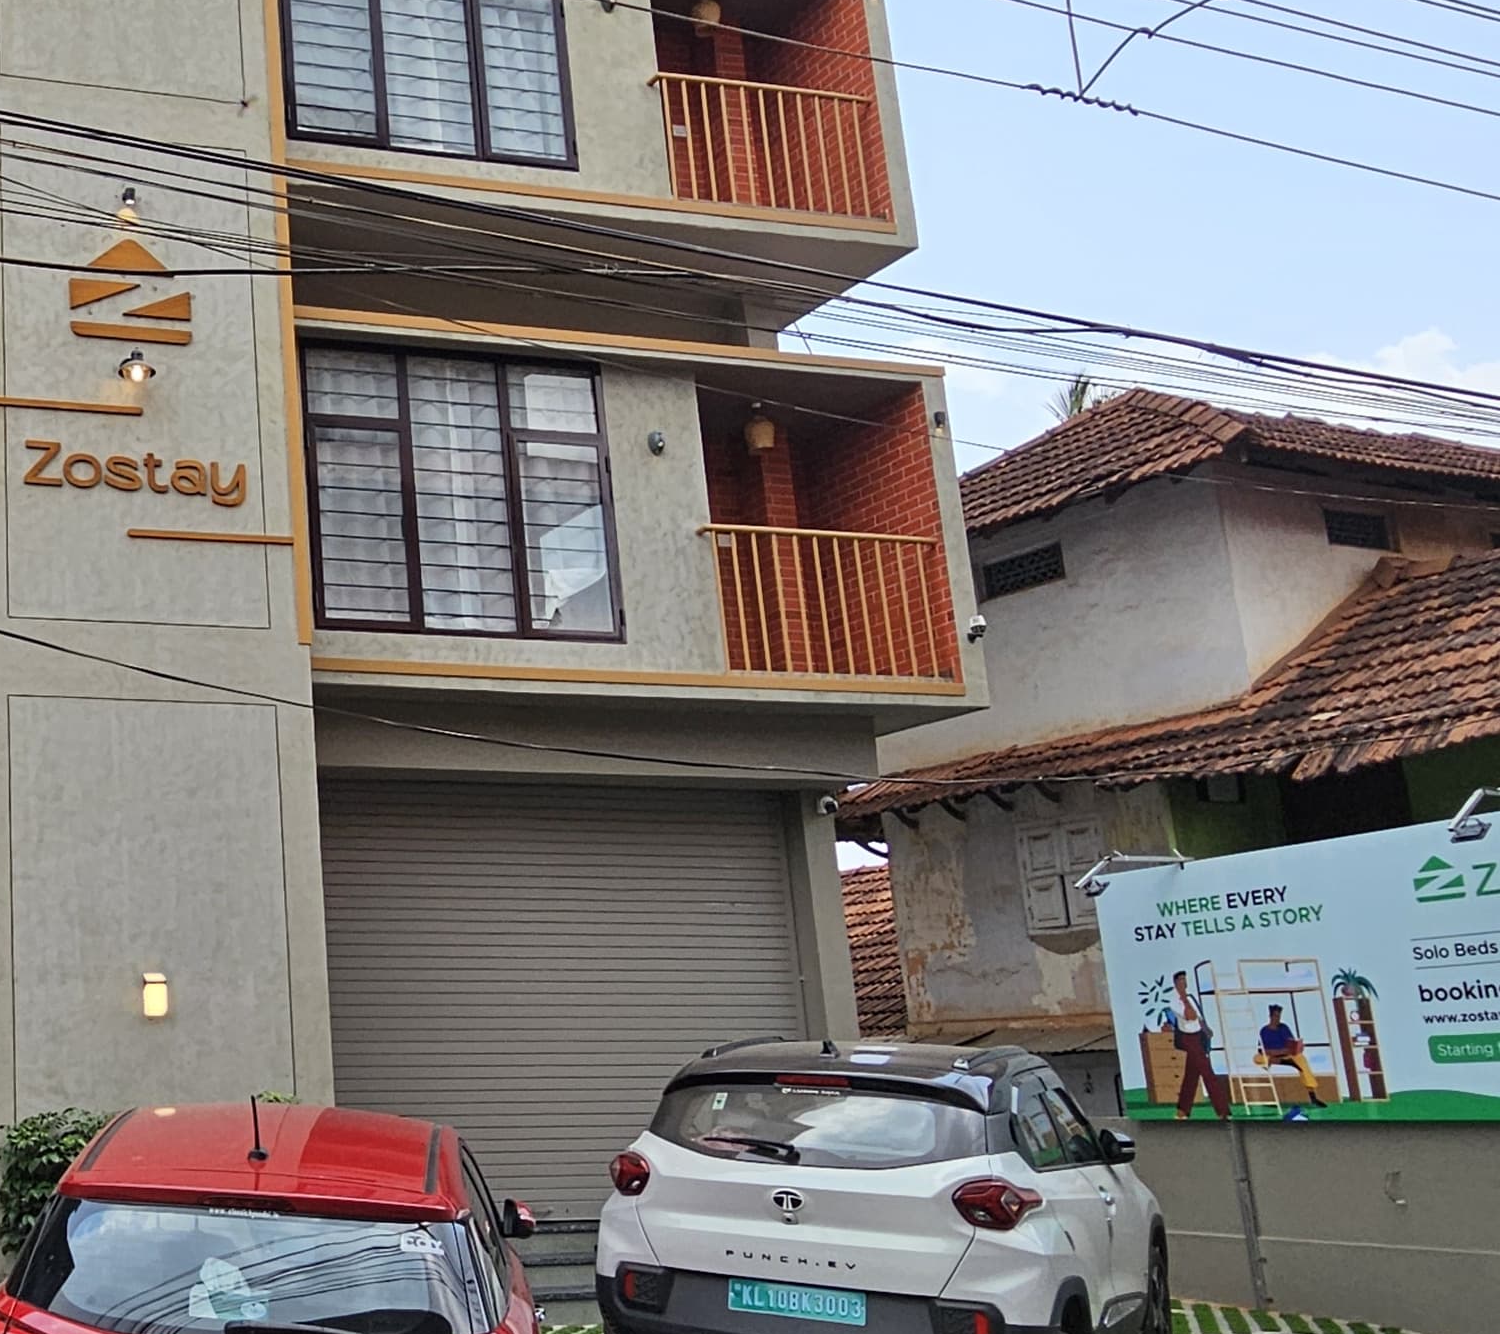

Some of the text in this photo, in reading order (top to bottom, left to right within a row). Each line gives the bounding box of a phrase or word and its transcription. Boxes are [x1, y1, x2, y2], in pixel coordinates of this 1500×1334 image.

[24, 439, 248, 508] Zostay
[1156, 885, 1288, 918] WHERE EVERY
[1134, 904, 1324, 942] STAY TELLS A STORY
[1412, 939, 1499, 961] Solo Beds
[1417, 979, 1500, 1002] bookin
[1423, 1010, 1500, 1024] www.zosta
[1437, 1043, 1494, 1058] Starting
